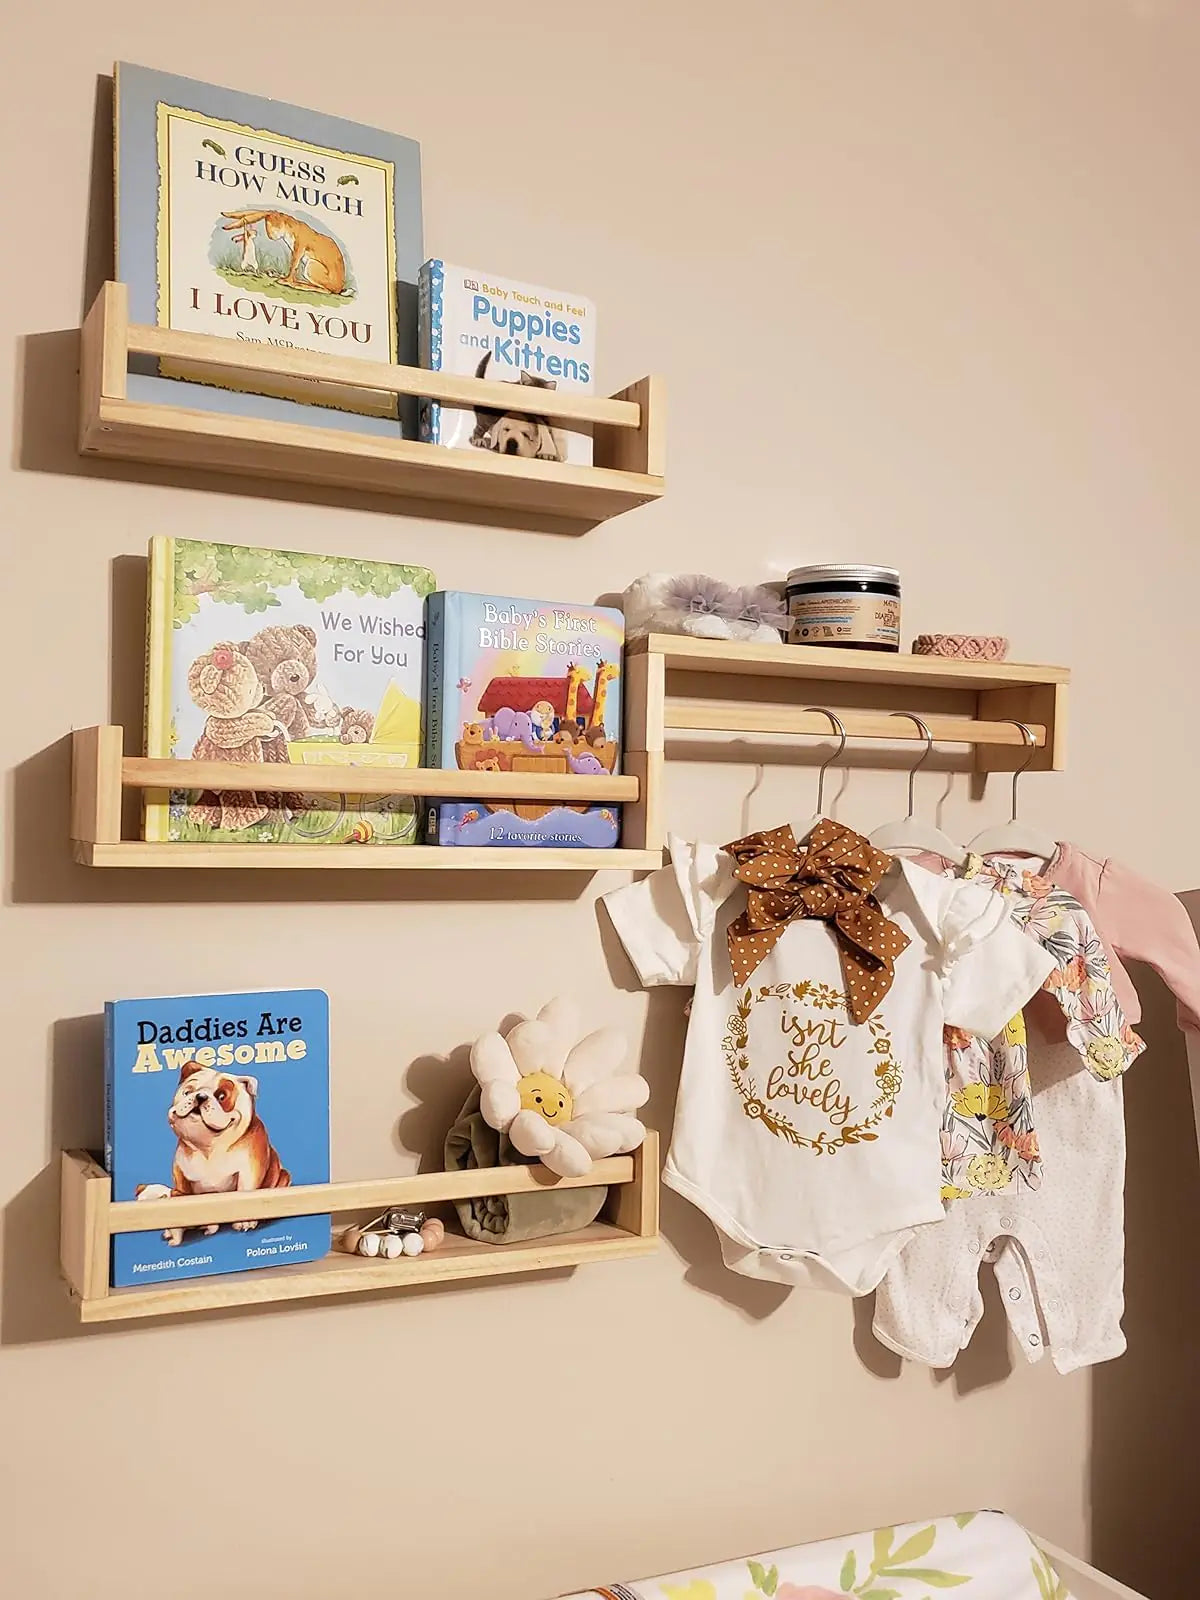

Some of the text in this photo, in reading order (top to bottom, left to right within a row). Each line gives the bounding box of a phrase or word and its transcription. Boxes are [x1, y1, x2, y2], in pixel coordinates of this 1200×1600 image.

[235, 145, 326, 184] GUESS
[195, 159, 364, 217] HOW MUCH
[189, 287, 373, 344] I LOVE YOU
[482, 283, 586, 317] Baby Touch and Feel
[472, 295, 581, 345] Puppies
[459, 333, 590, 383] and Kittens
[321, 611, 426, 640] We Wished
[483, 603, 597, 632] Baby's First
[334, 643, 408, 668] For You
[478, 627, 601, 658] Bible Stories
[490, 827, 504, 840] 12
[549, 832, 584, 842] stories
[137, 1017, 248, 1045] Daddies
[256, 1012, 303, 1036] Are
[132, 1038, 307, 1073] Awesome
[787, 1043, 833, 1081] she
[766, 1066, 858, 1126] lovely
[132, 1255, 213, 1273] Meredith Costain
[246, 1246, 277, 1257] Polona
